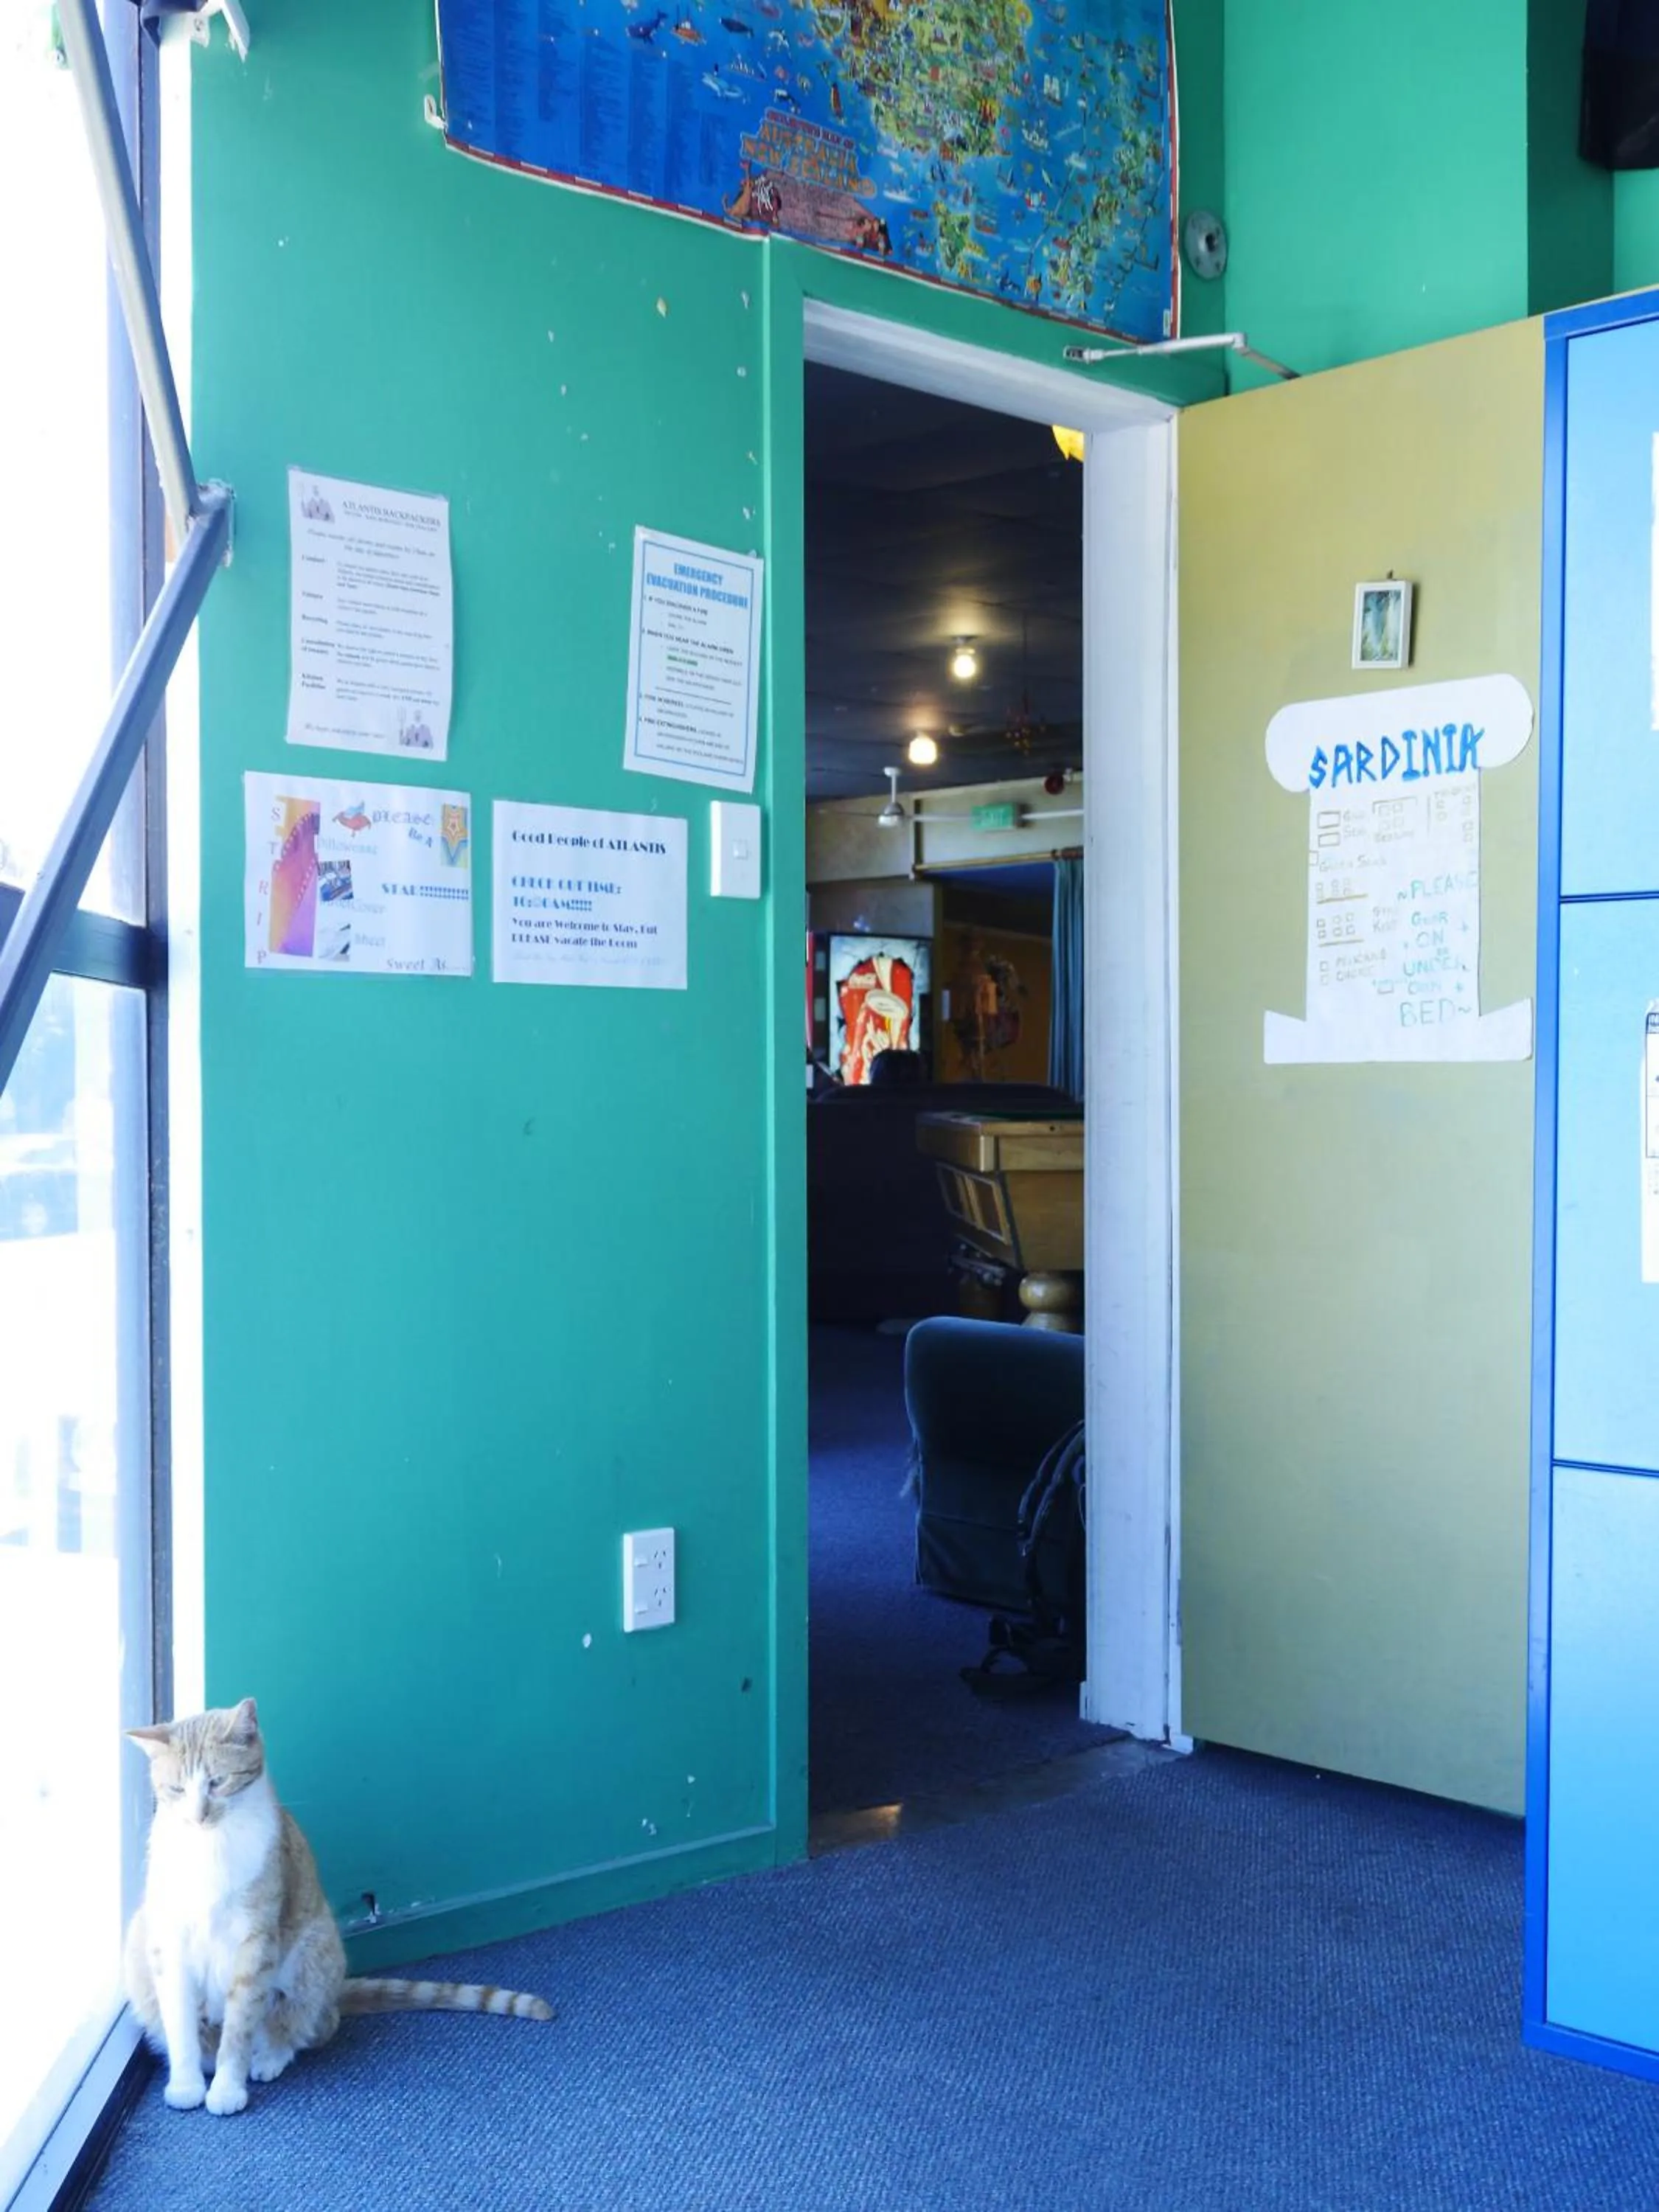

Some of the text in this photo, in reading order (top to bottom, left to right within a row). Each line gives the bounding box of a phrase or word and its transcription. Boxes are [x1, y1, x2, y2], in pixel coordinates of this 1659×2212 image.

[673, 563, 723, 586] EMERGENCY
[646, 572, 748, 609] EVACUATION PROCEDURE
[1308, 723, 1485, 789] SARDINIA
[512, 830, 667, 855] Good People of ATLANTIS
[512, 917, 532, 928] You
[533, 919, 553, 929] are
[554, 919, 600, 932] Welcome
[601, 922, 610, 933] to
[512, 932, 553, 945] PLEASE
[591, 936, 608, 947] the
[1416, 927, 1445, 948] ON
